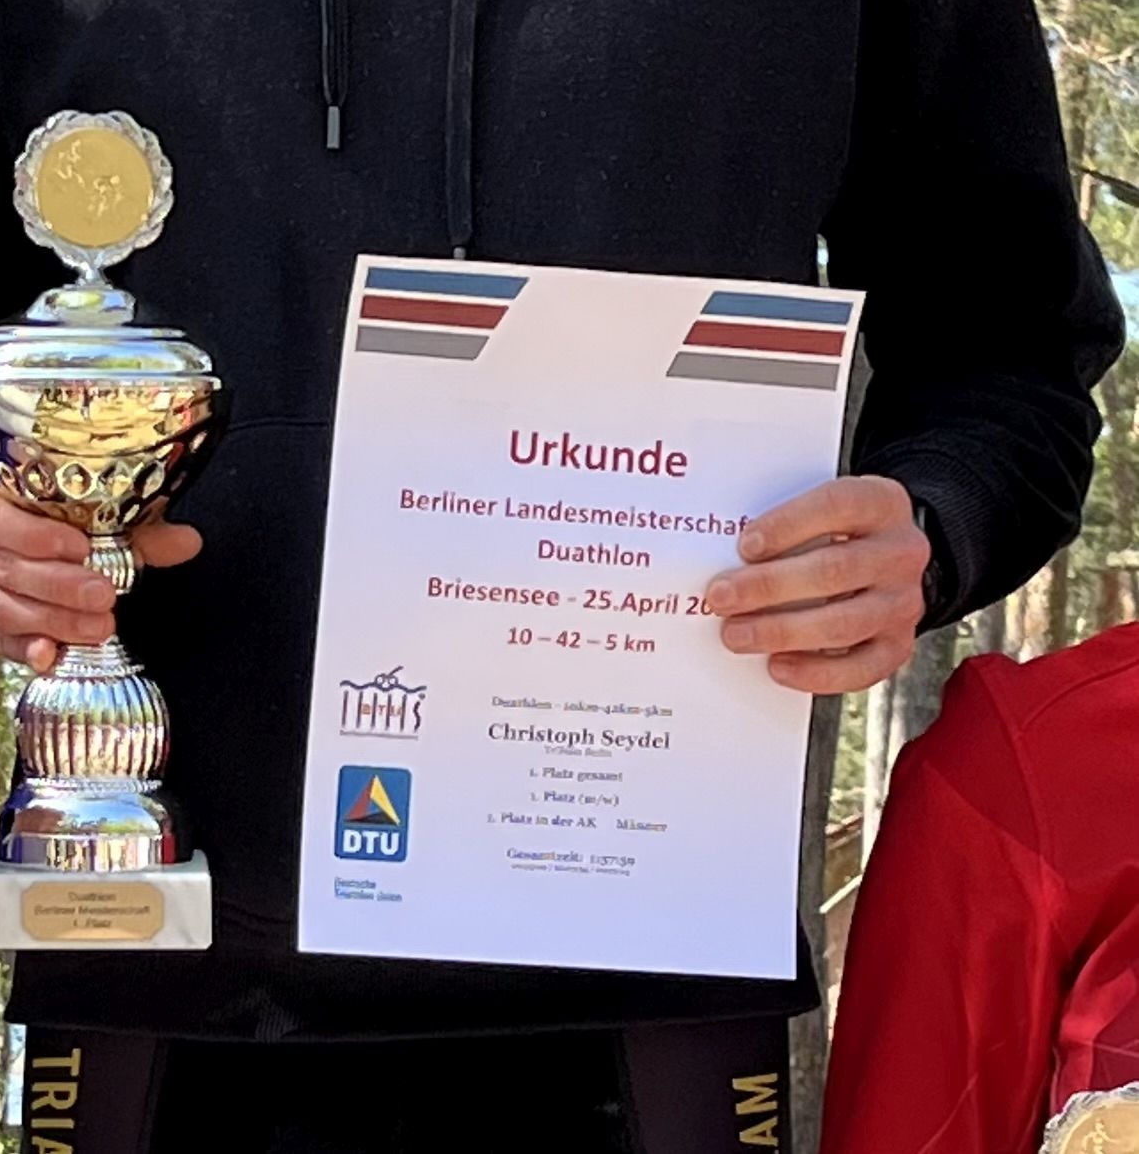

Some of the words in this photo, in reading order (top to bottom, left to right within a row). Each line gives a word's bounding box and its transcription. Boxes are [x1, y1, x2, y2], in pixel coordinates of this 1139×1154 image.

[509, 430, 688, 478] Urkunde
[399, 488, 498, 516] Berliner
[504, 496, 750, 536] Landesmeisterschaf
[537, 539, 651, 568] Duathlon
[426, 577, 560, 607] Briesensee
[582, 589, 679, 617] 25.April
[685, 595, 714, 617] 20
[507, 627, 533, 647] 10
[556, 630, 582, 649] 42
[605, 633, 618, 652] 5
[624, 634, 656, 653] km
[488, 723, 595, 747] Christoph
[600, 730, 671, 752] Seydel
[544, 791, 576, 804] Platz
[551, 815, 574, 827] der
[576, 817, 597, 829] AK
[342, 829, 400, 856] DTU
[732, 1072, 779, 1154] AM
